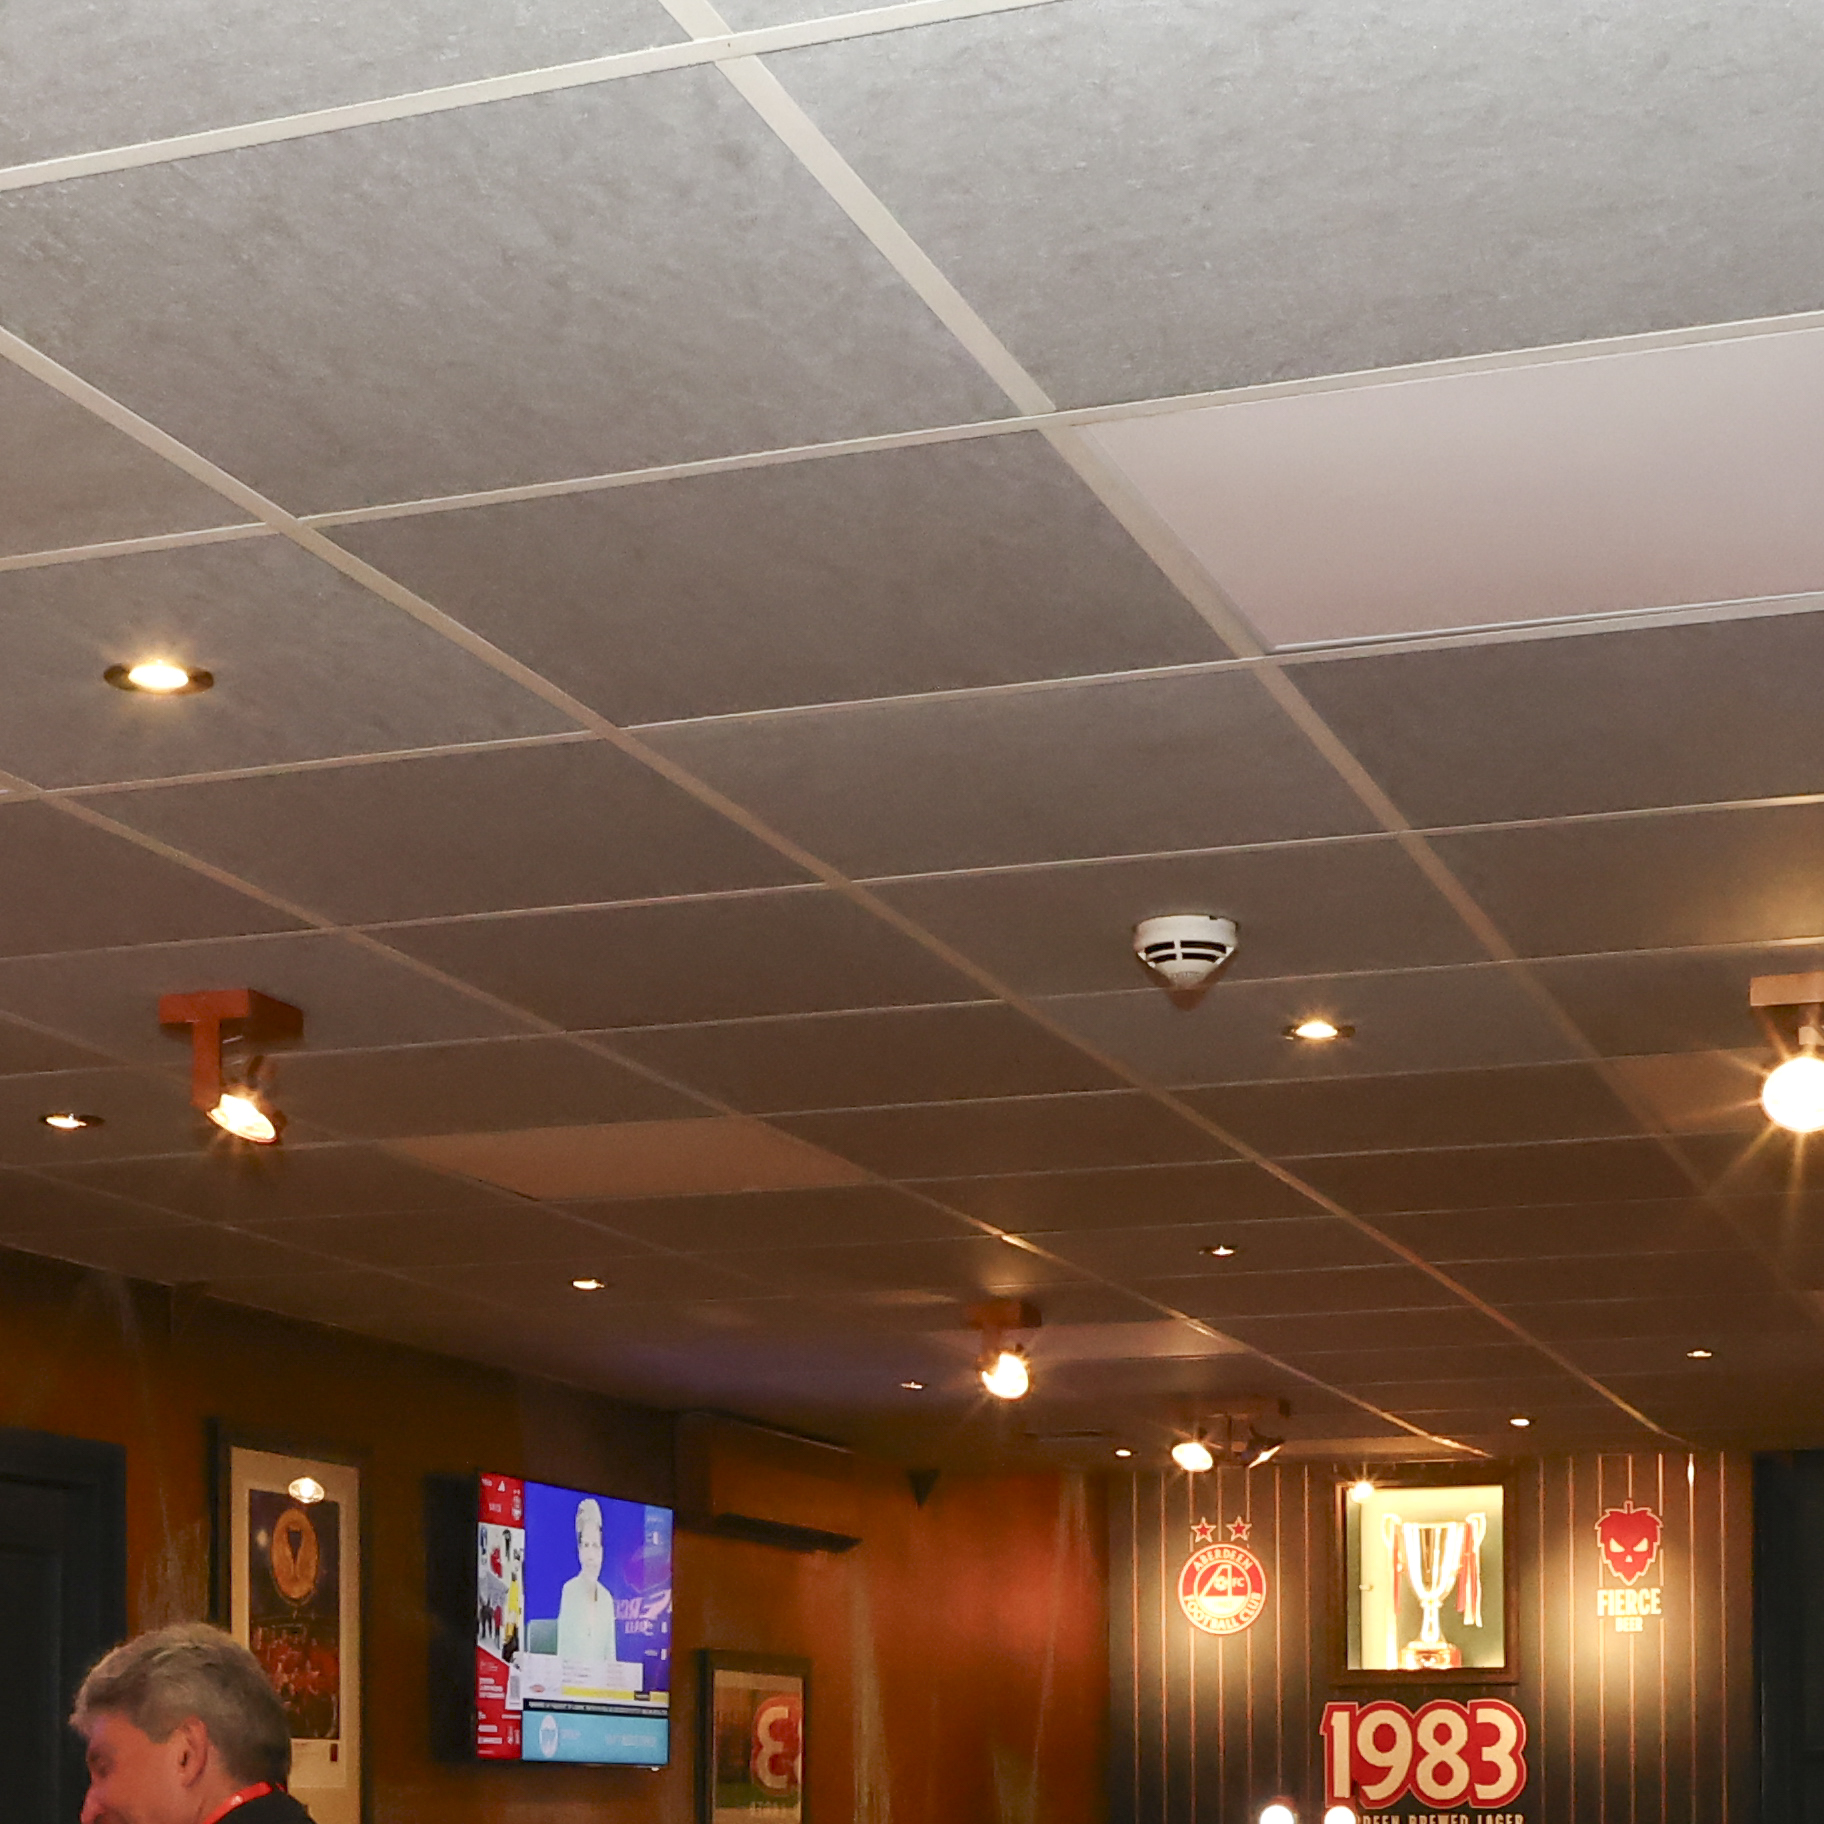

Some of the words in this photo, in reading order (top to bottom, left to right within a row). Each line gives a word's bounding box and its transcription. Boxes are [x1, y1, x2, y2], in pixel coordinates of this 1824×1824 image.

[1194, 1549, 1253, 1572] ABERDEEN
[1184, 1594, 1240, 1631] FOOTBALL
[1240, 1592, 1261, 1622] CLUB
[1597, 1588, 1662, 1616] FIERCE
[1616, 1616, 1643, 1632] BEER
[1331, 1708, 1519, 1801] 1983
